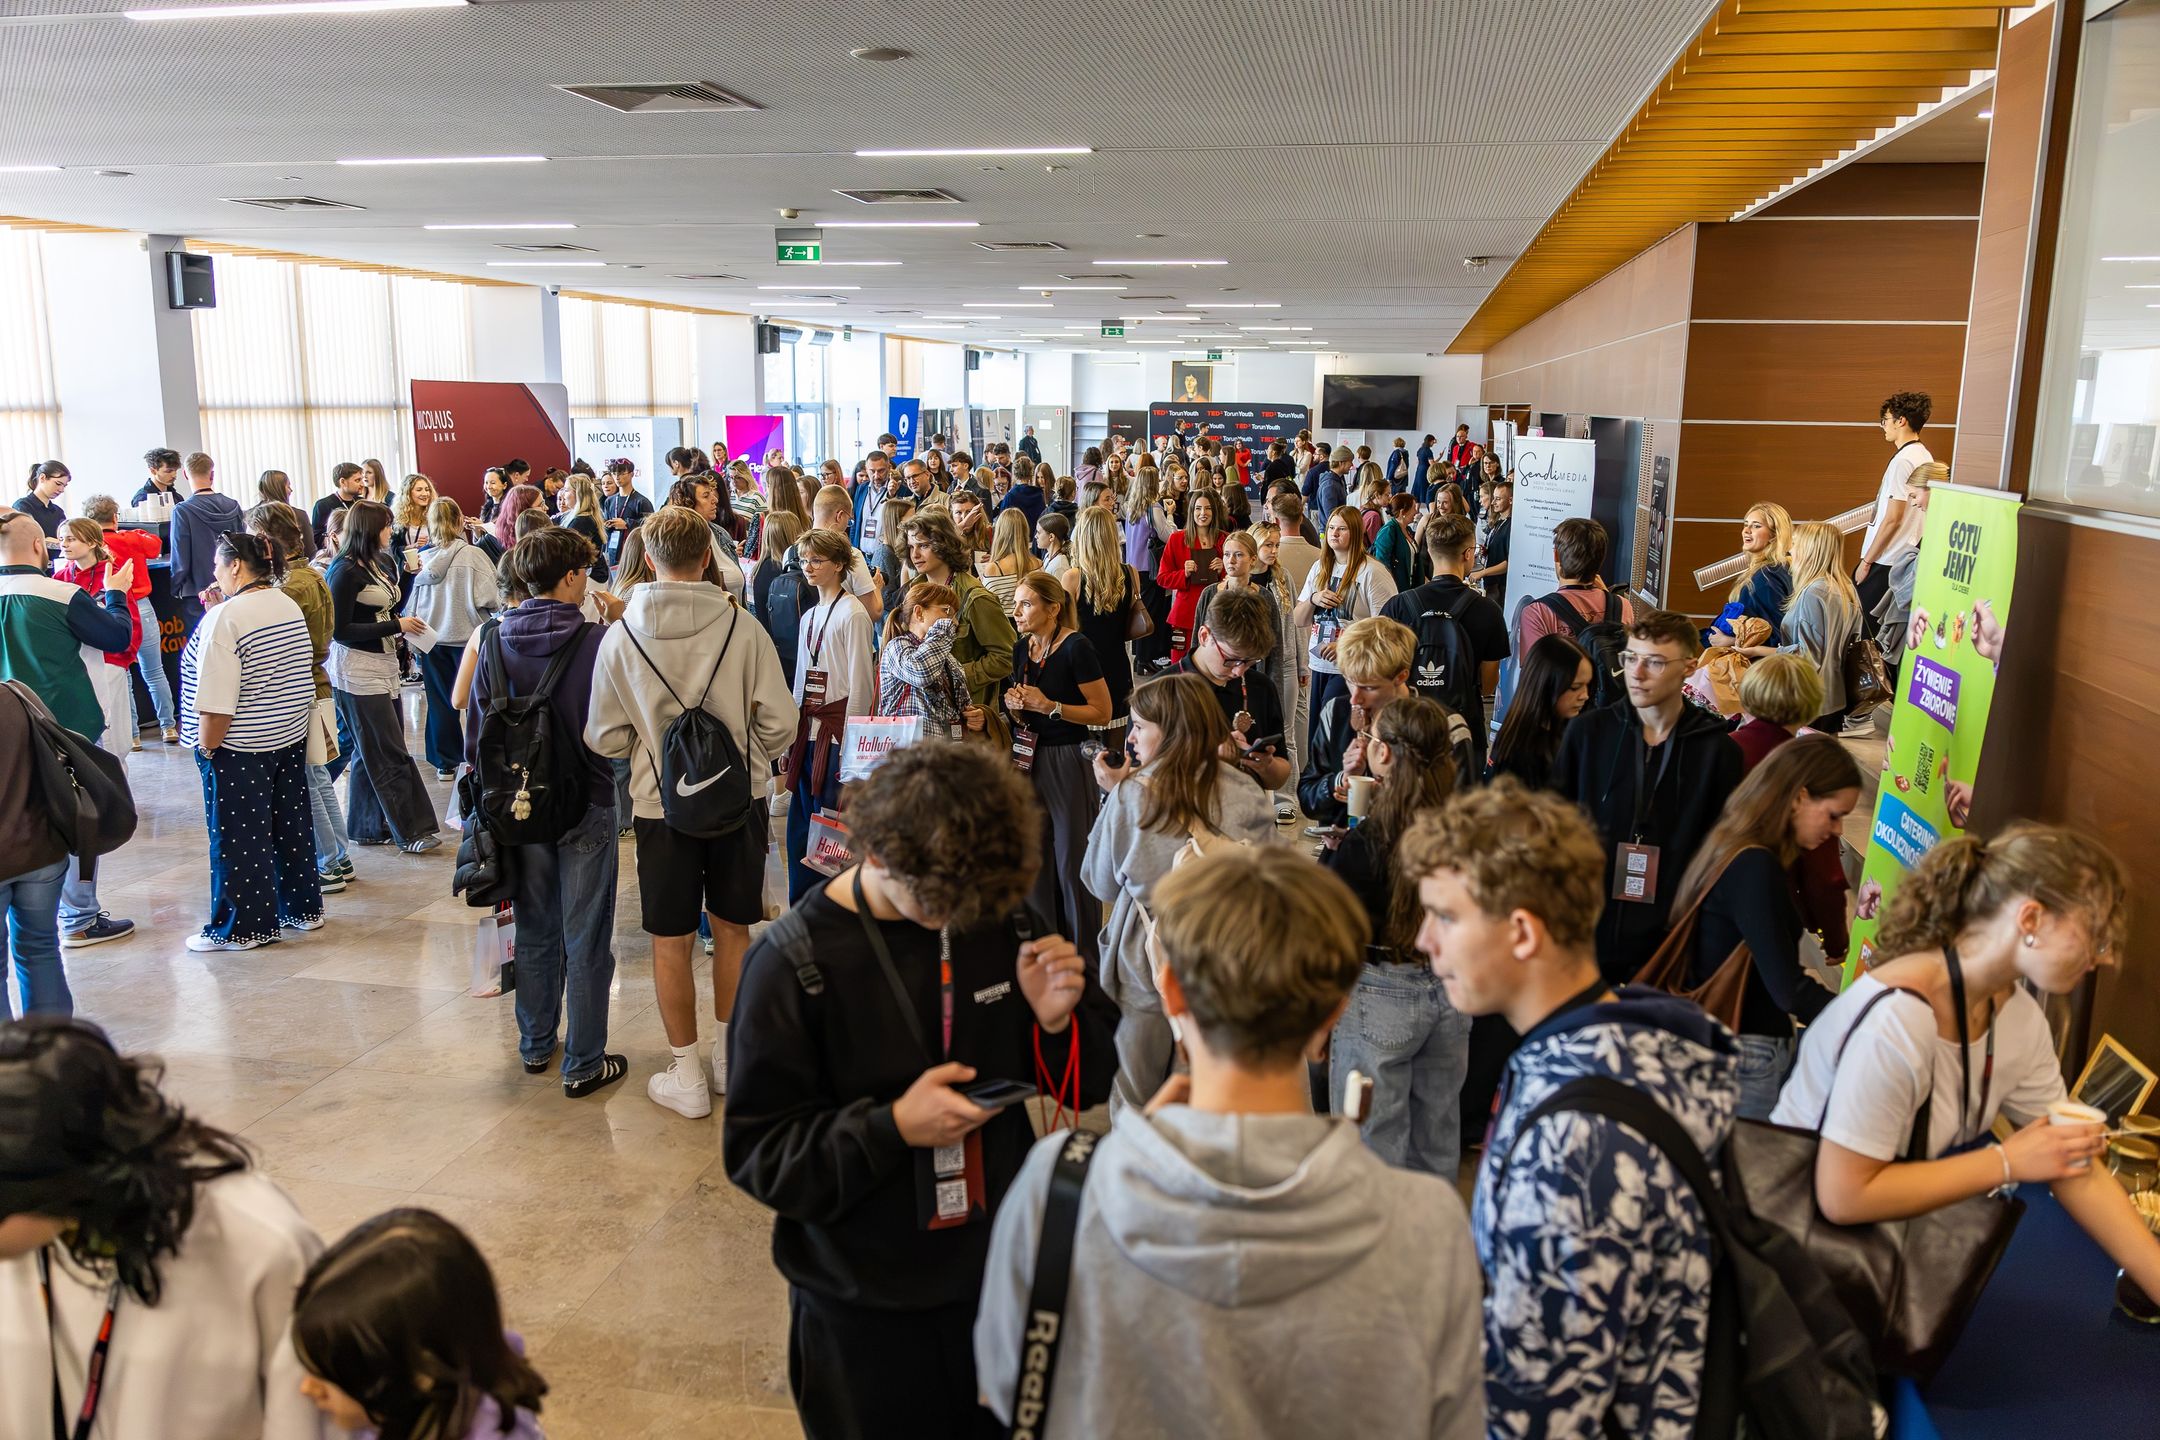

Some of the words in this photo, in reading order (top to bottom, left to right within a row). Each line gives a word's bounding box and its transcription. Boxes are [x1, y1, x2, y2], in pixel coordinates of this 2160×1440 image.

[416, 410, 454, 430] NICOLAUS
[433, 432, 456, 442] BANK
[587, 432, 641, 443] NICOLAUS
[1949, 520, 1982, 555] GOTU
[1942, 550, 1977, 585] JEMY
[857, 735, 897, 752] Hallufix
[1875, 820, 1921, 866] OKOLICZNOŚ
